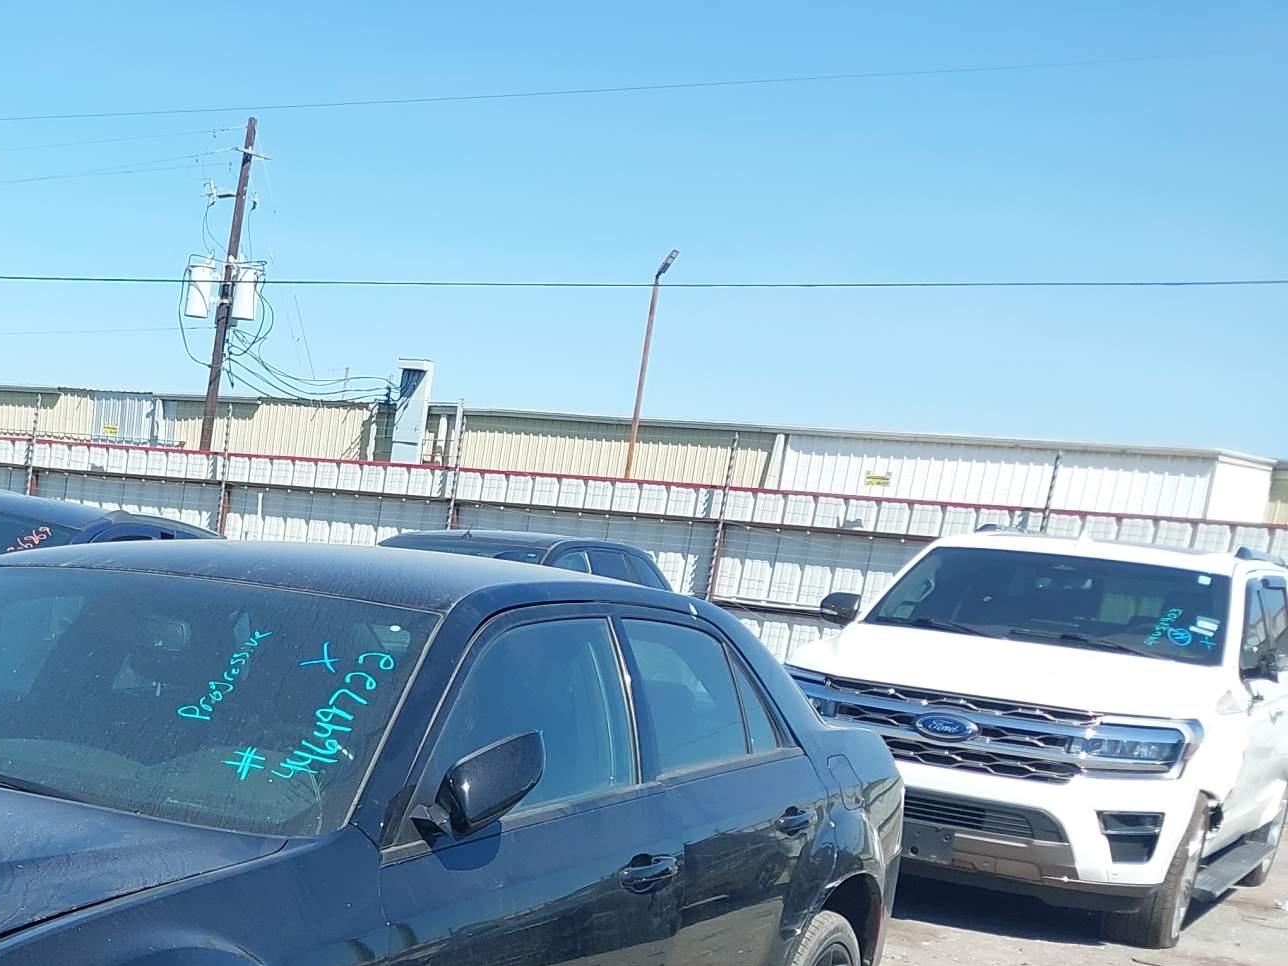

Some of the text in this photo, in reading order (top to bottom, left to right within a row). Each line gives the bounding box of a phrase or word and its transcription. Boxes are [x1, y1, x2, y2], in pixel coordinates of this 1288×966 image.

[178, 631, 272, 720] Progressive
[271, 652, 394, 779] 44649722
[928, 719, 960, 734] Ford
